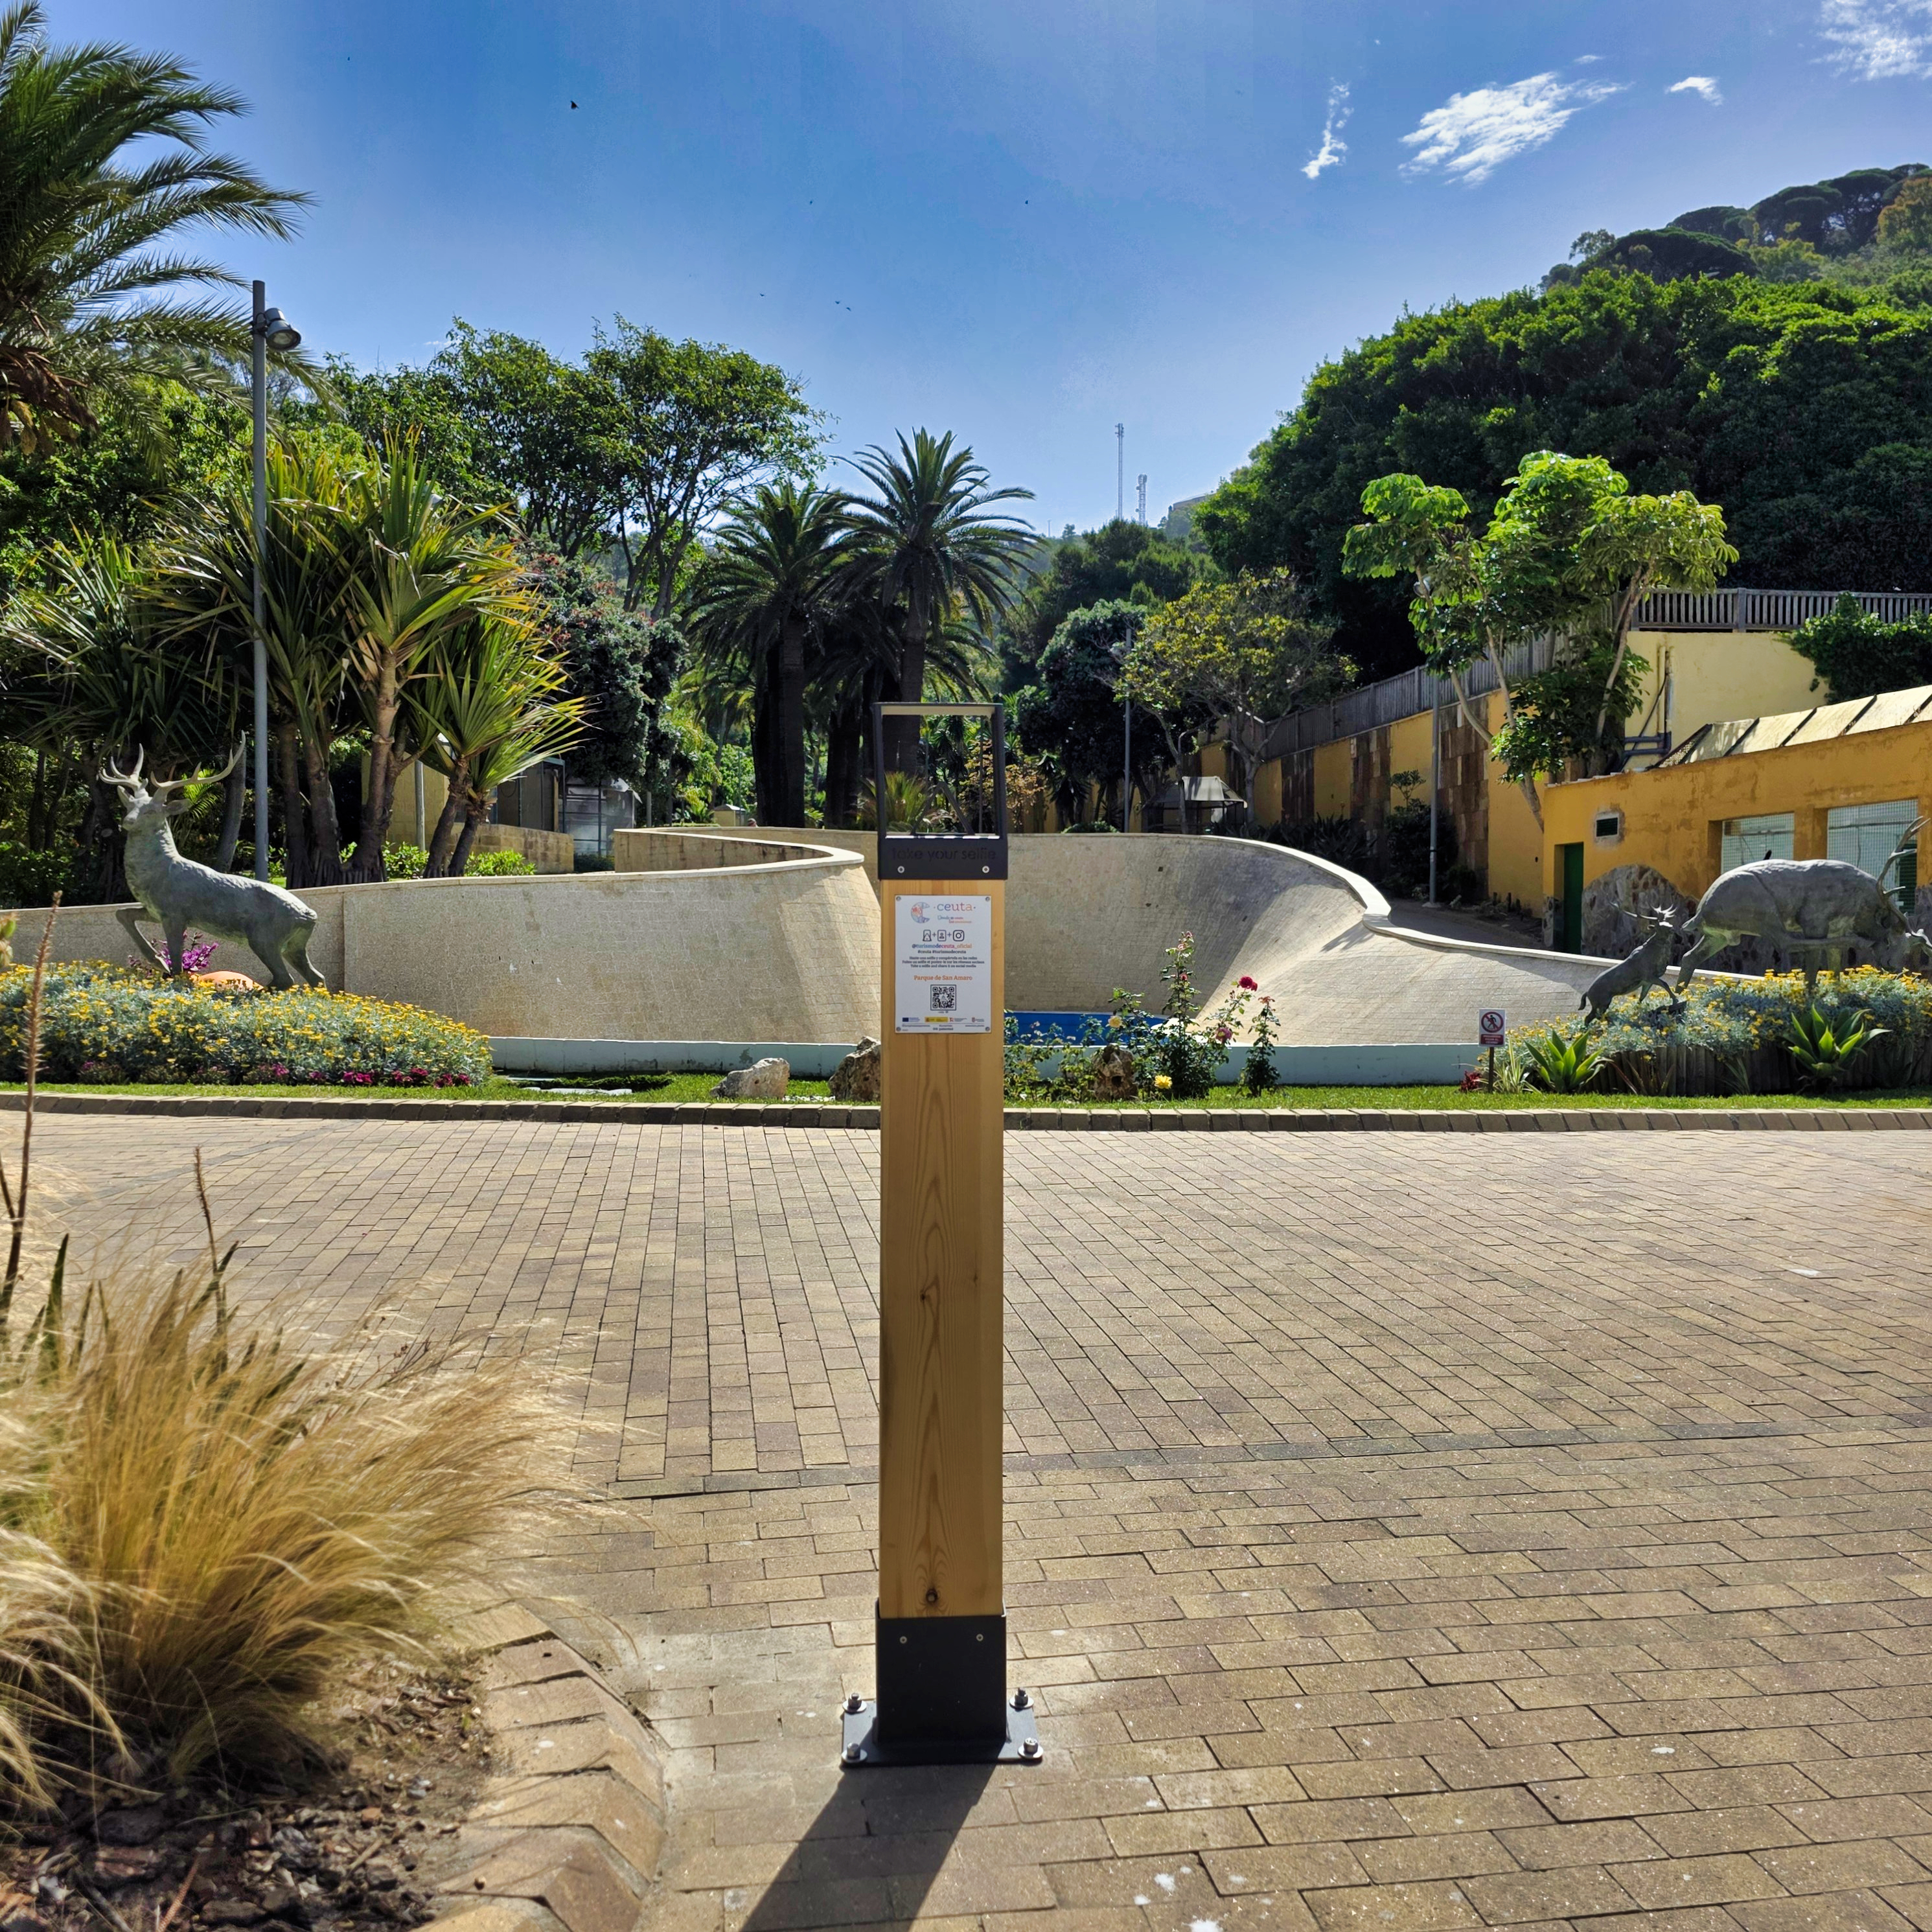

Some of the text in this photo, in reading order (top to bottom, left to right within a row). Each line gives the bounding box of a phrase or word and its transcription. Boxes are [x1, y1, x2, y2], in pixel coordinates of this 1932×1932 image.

[892, 847, 996, 862] take your selfie
